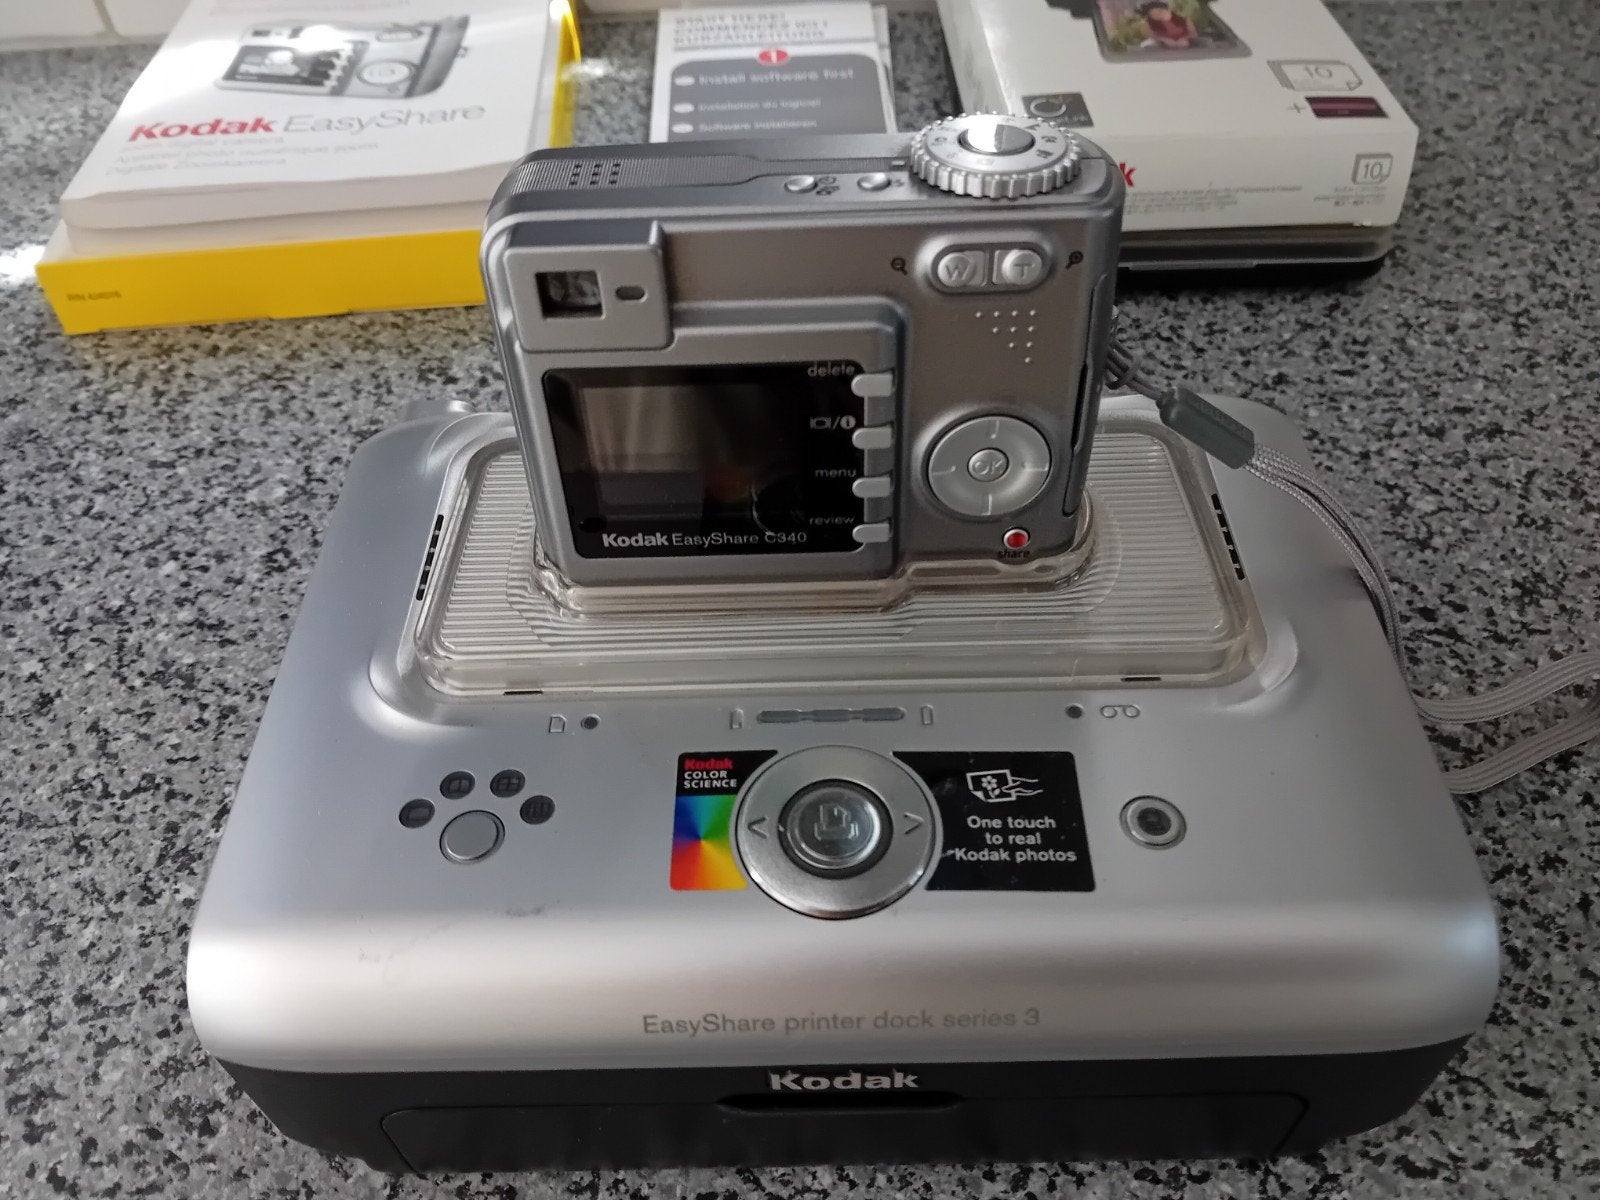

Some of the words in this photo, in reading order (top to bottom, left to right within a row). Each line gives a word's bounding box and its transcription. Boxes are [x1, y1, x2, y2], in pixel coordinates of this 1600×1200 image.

[1305, 66, 1333, 80] 10
[128, 116, 275, 142] Kodak
[283, 104, 487, 136] EasyShare
[1364, 162, 1383, 180] 10
[946, 261, 975, 281] W
[1013, 262, 1036, 280] T
[807, 360, 856, 377] delete
[815, 468, 857, 478] menu
[973, 460, 1004, 475] OK
[809, 516, 855, 526] review
[602, 532, 669, 547] Kodak
[672, 531, 759, 548] EasyShare
[764, 531, 807, 545] C340
[997, 549, 1031, 559] share
[684, 757, 734, 770] Kodak
[684, 770, 728, 780] COLOR
[683, 779, 737, 789] SCIENCE
[966, 815, 1002, 829] One
[1007, 815, 1056, 829] touch
[985, 832, 1003, 845] to
[1008, 831, 1042, 845] real
[955, 848, 1011, 861] Kodak
[1015, 848, 1077, 864] photos
[642, 1012, 775, 1038] EasyShare
[784, 1011, 864, 1036] printer
[873, 1009, 935, 1030] dock
[943, 1009, 1016, 1029] series
[1023, 1007, 1040, 1027] 3
[768, 1071, 919, 1091] Kodak
